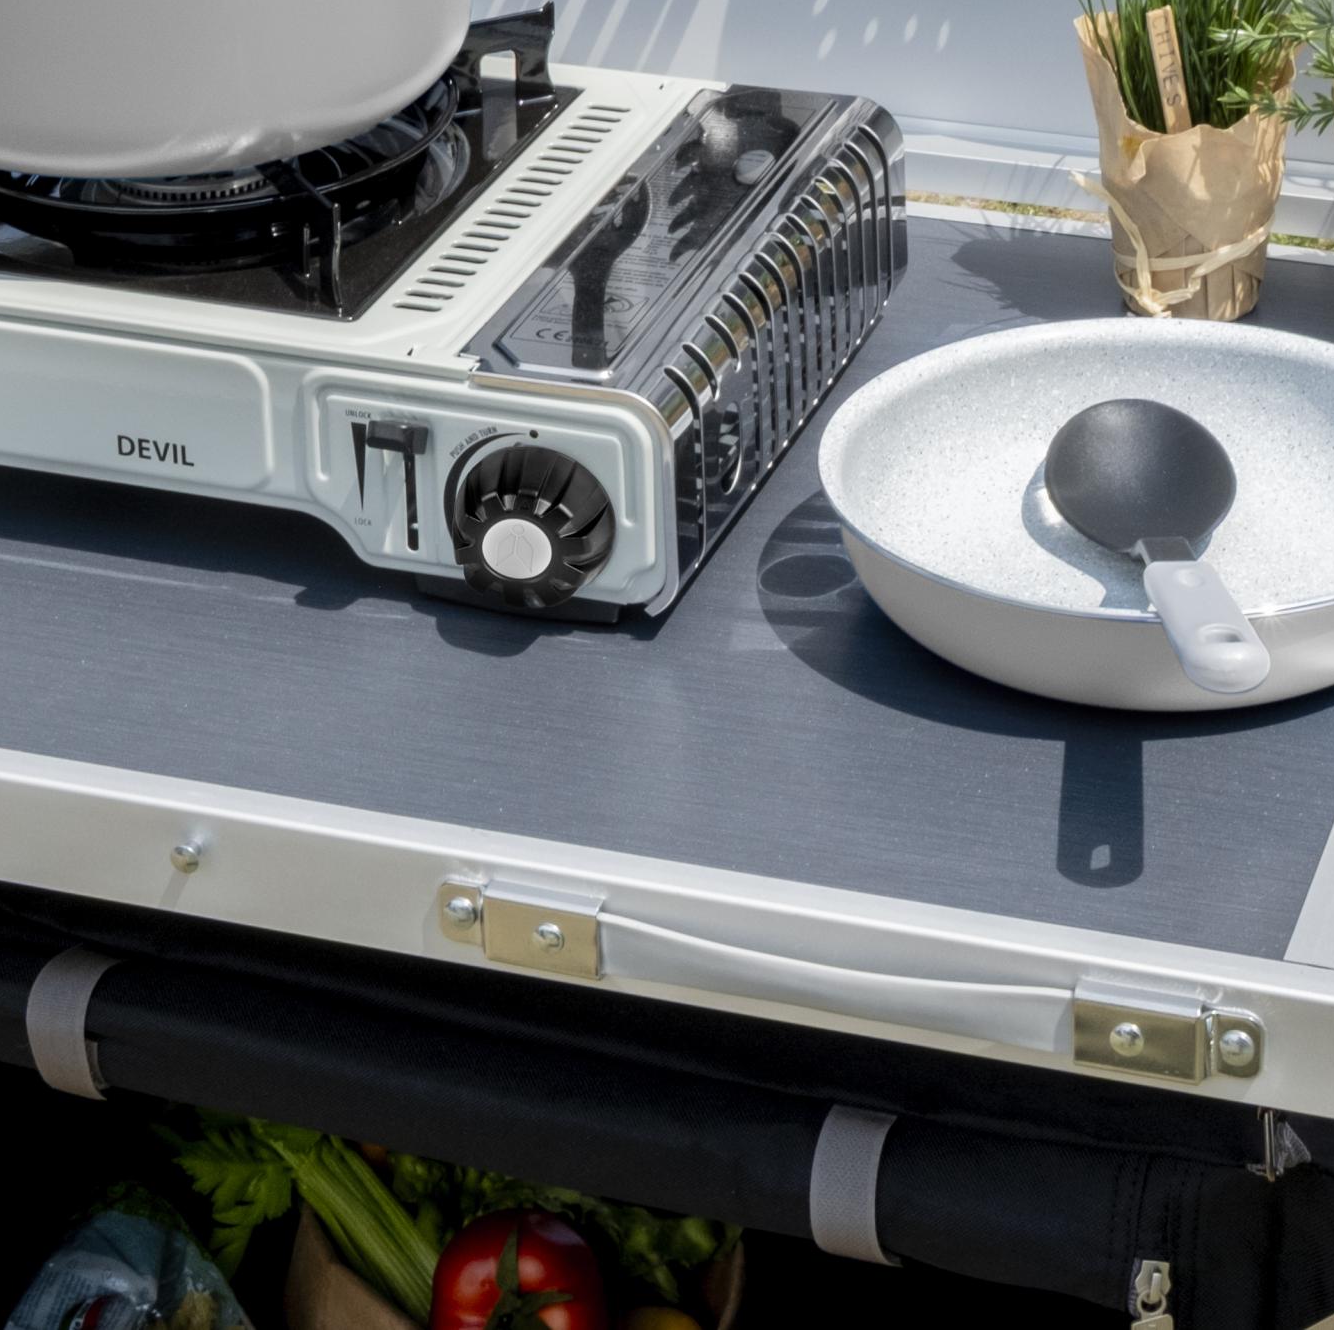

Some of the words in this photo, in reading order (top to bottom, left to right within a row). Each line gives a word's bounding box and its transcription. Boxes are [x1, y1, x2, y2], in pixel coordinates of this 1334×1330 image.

[1152, 14, 1182, 106] CHIVES
[345, 409, 372, 419] UNLOCK
[117, 434, 195, 467] DEVIL
[450, 444, 464, 458] PUSH
[464, 431, 479, 447] AND
[478, 425, 498, 438] TURN
